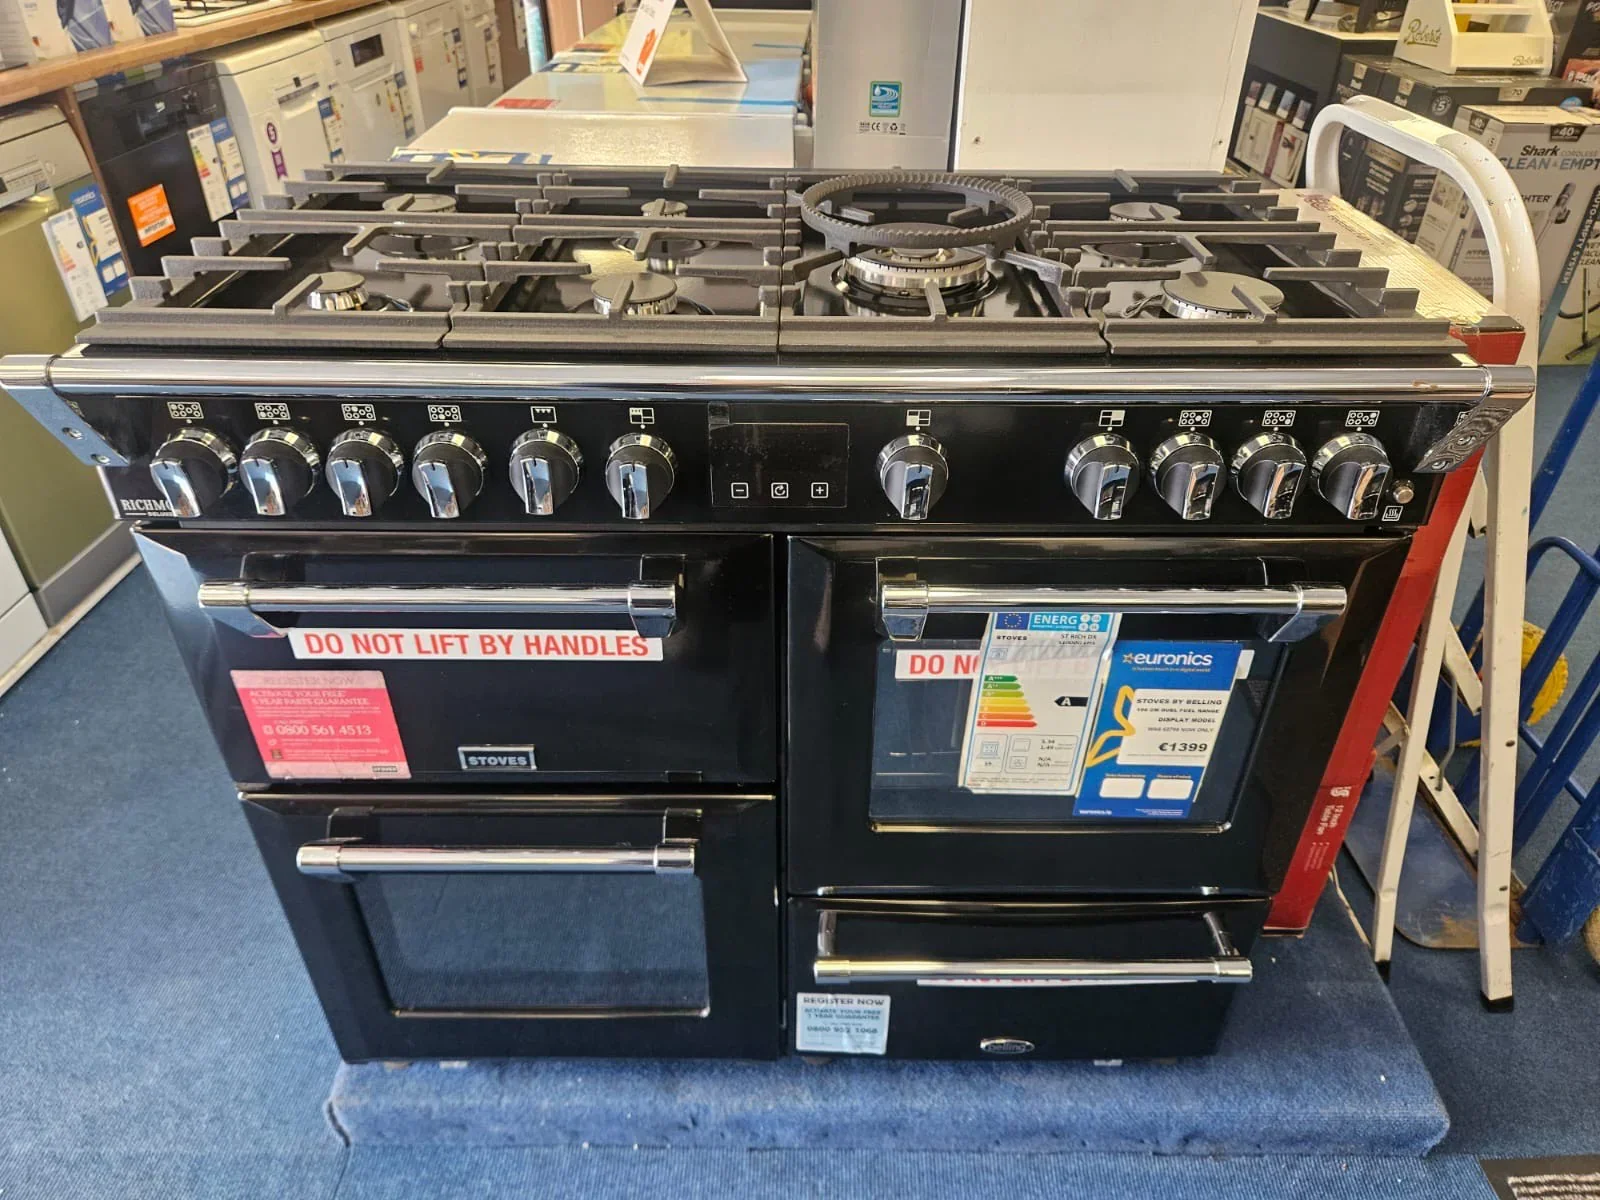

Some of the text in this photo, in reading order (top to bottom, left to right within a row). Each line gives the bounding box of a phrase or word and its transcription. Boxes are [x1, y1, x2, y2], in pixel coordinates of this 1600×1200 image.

[1559, 127, 1575, 136] 40
[1520, 145, 1560, 157] Shark
[1500, 157, 1551, 170] CLEAN
[1034, 614, 1077, 625] ENERG
[304, 633, 649, 657] DO NOT LIFT BY HANDLES
[1134, 651, 1213, 666] euronics
[909, 654, 945, 675] DO
[1061, 697, 1072, 706] A
[276, 725, 373, 735] 0800 561 4513
[1159, 742, 1208, 752] €1399
[468, 756, 527, 766] STOVES
[803, 996, 885, 1006] REGISTER NOW
